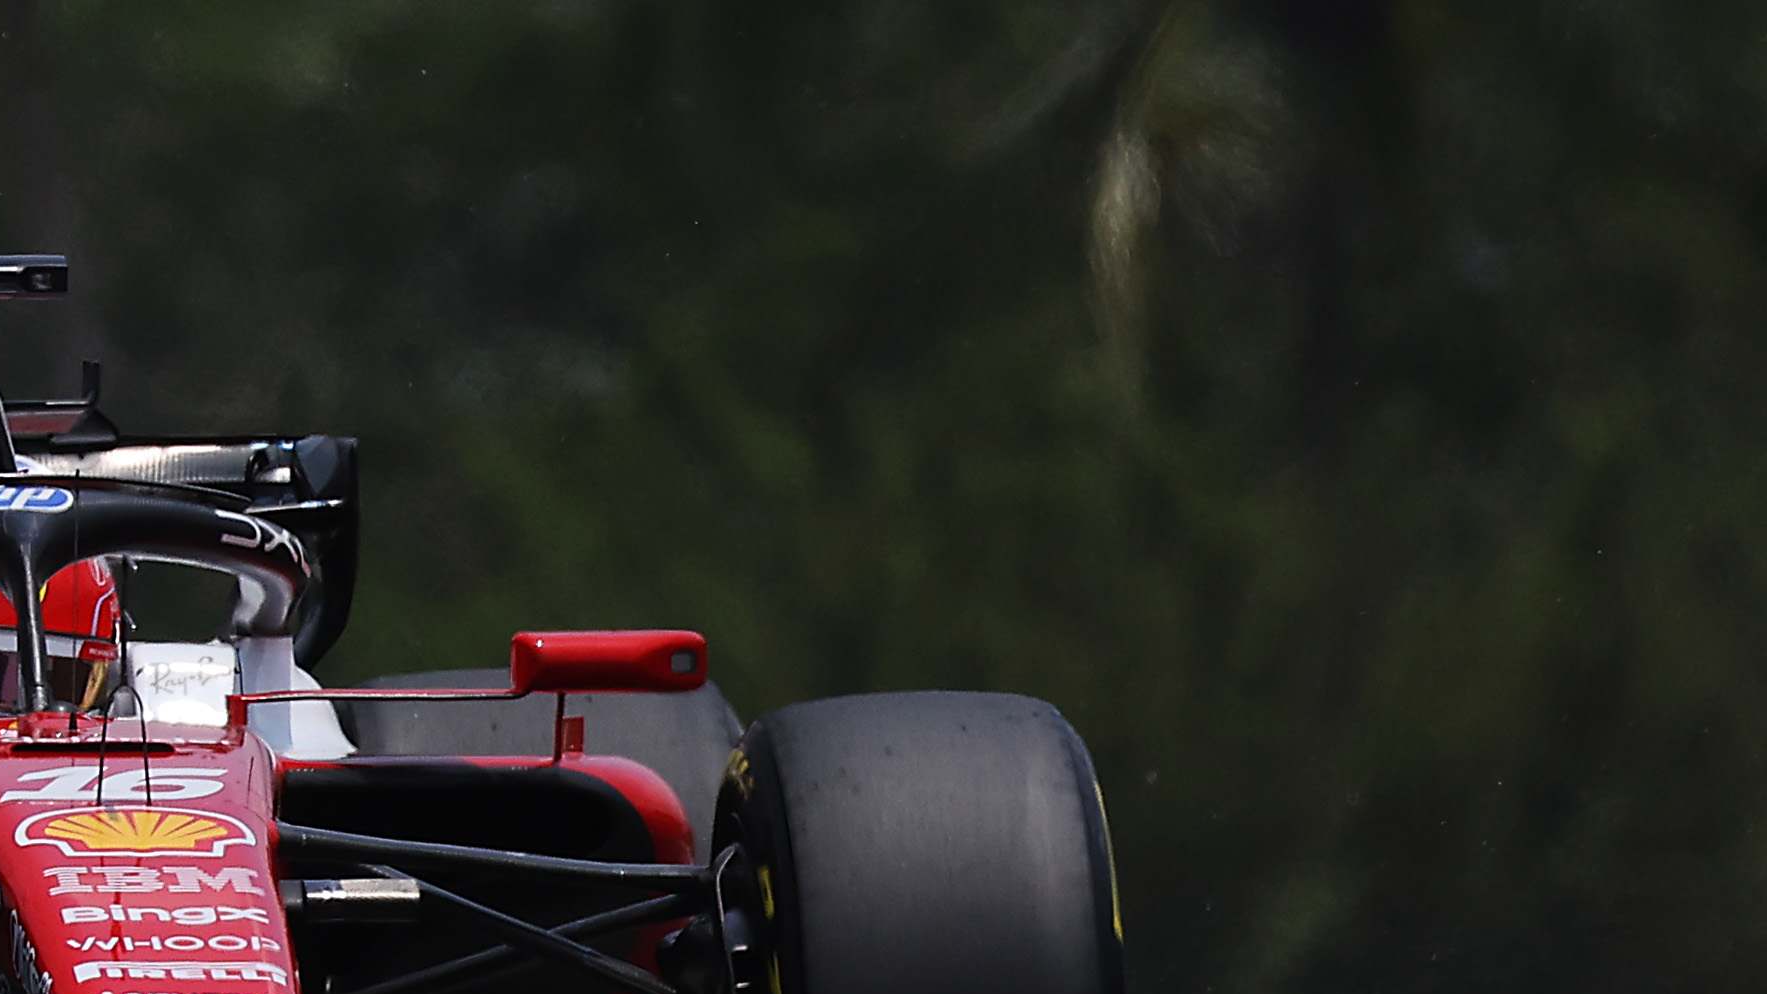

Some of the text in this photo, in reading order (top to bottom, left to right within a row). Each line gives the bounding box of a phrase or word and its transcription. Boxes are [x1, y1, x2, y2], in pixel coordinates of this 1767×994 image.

[0, 765, 228, 803] 16
[43, 866, 265, 896] IBM
[66, 935, 281, 951] WHOOP
[73, 960, 288, 986] PIRELLI
